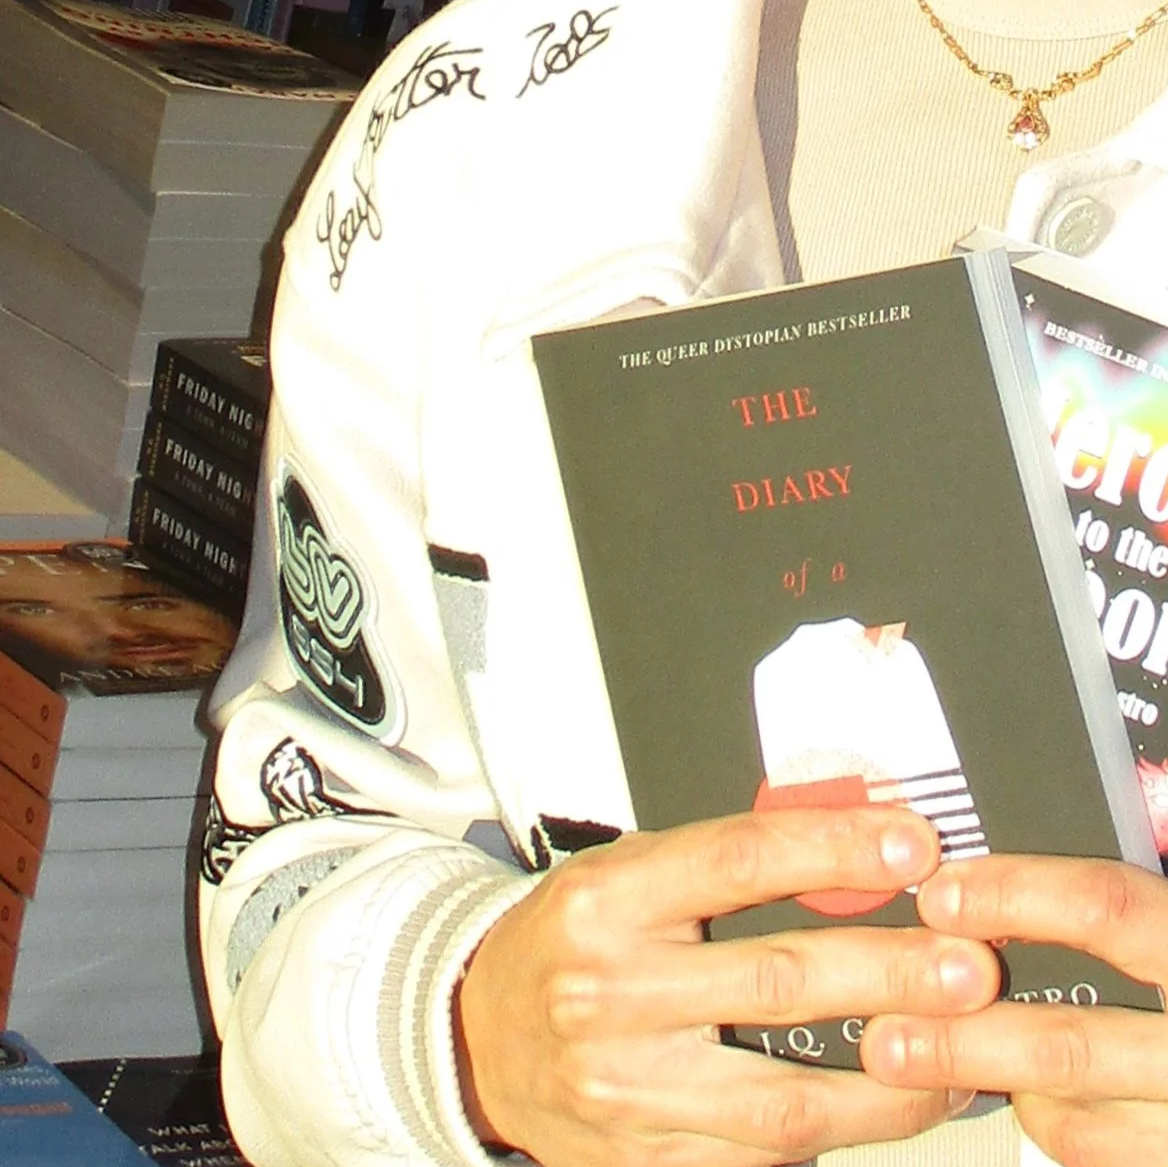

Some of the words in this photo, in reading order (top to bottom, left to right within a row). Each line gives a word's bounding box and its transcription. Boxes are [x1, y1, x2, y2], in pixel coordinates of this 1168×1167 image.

[618, 350, 652, 369] THE
[656, 340, 709, 366] QUEER
[714, 323, 802, 354] DYSTOPIAN
[806, 304, 912, 338] BESTSELLER
[1043, 320, 1149, 375] BESTSELLER
[176, 372, 227, 416] FRIDAY
[731, 386, 818, 429] THE
[164, 437, 214, 482] FRIDAY
[731, 464, 853, 514] DIARY
[151, 506, 202, 552] FRIDAY
[1075, 508, 1110, 554] to
[783, 556, 813, 598] of
[830, 560, 848, 584] a
[147, 1122, 211, 1138] WHAT
